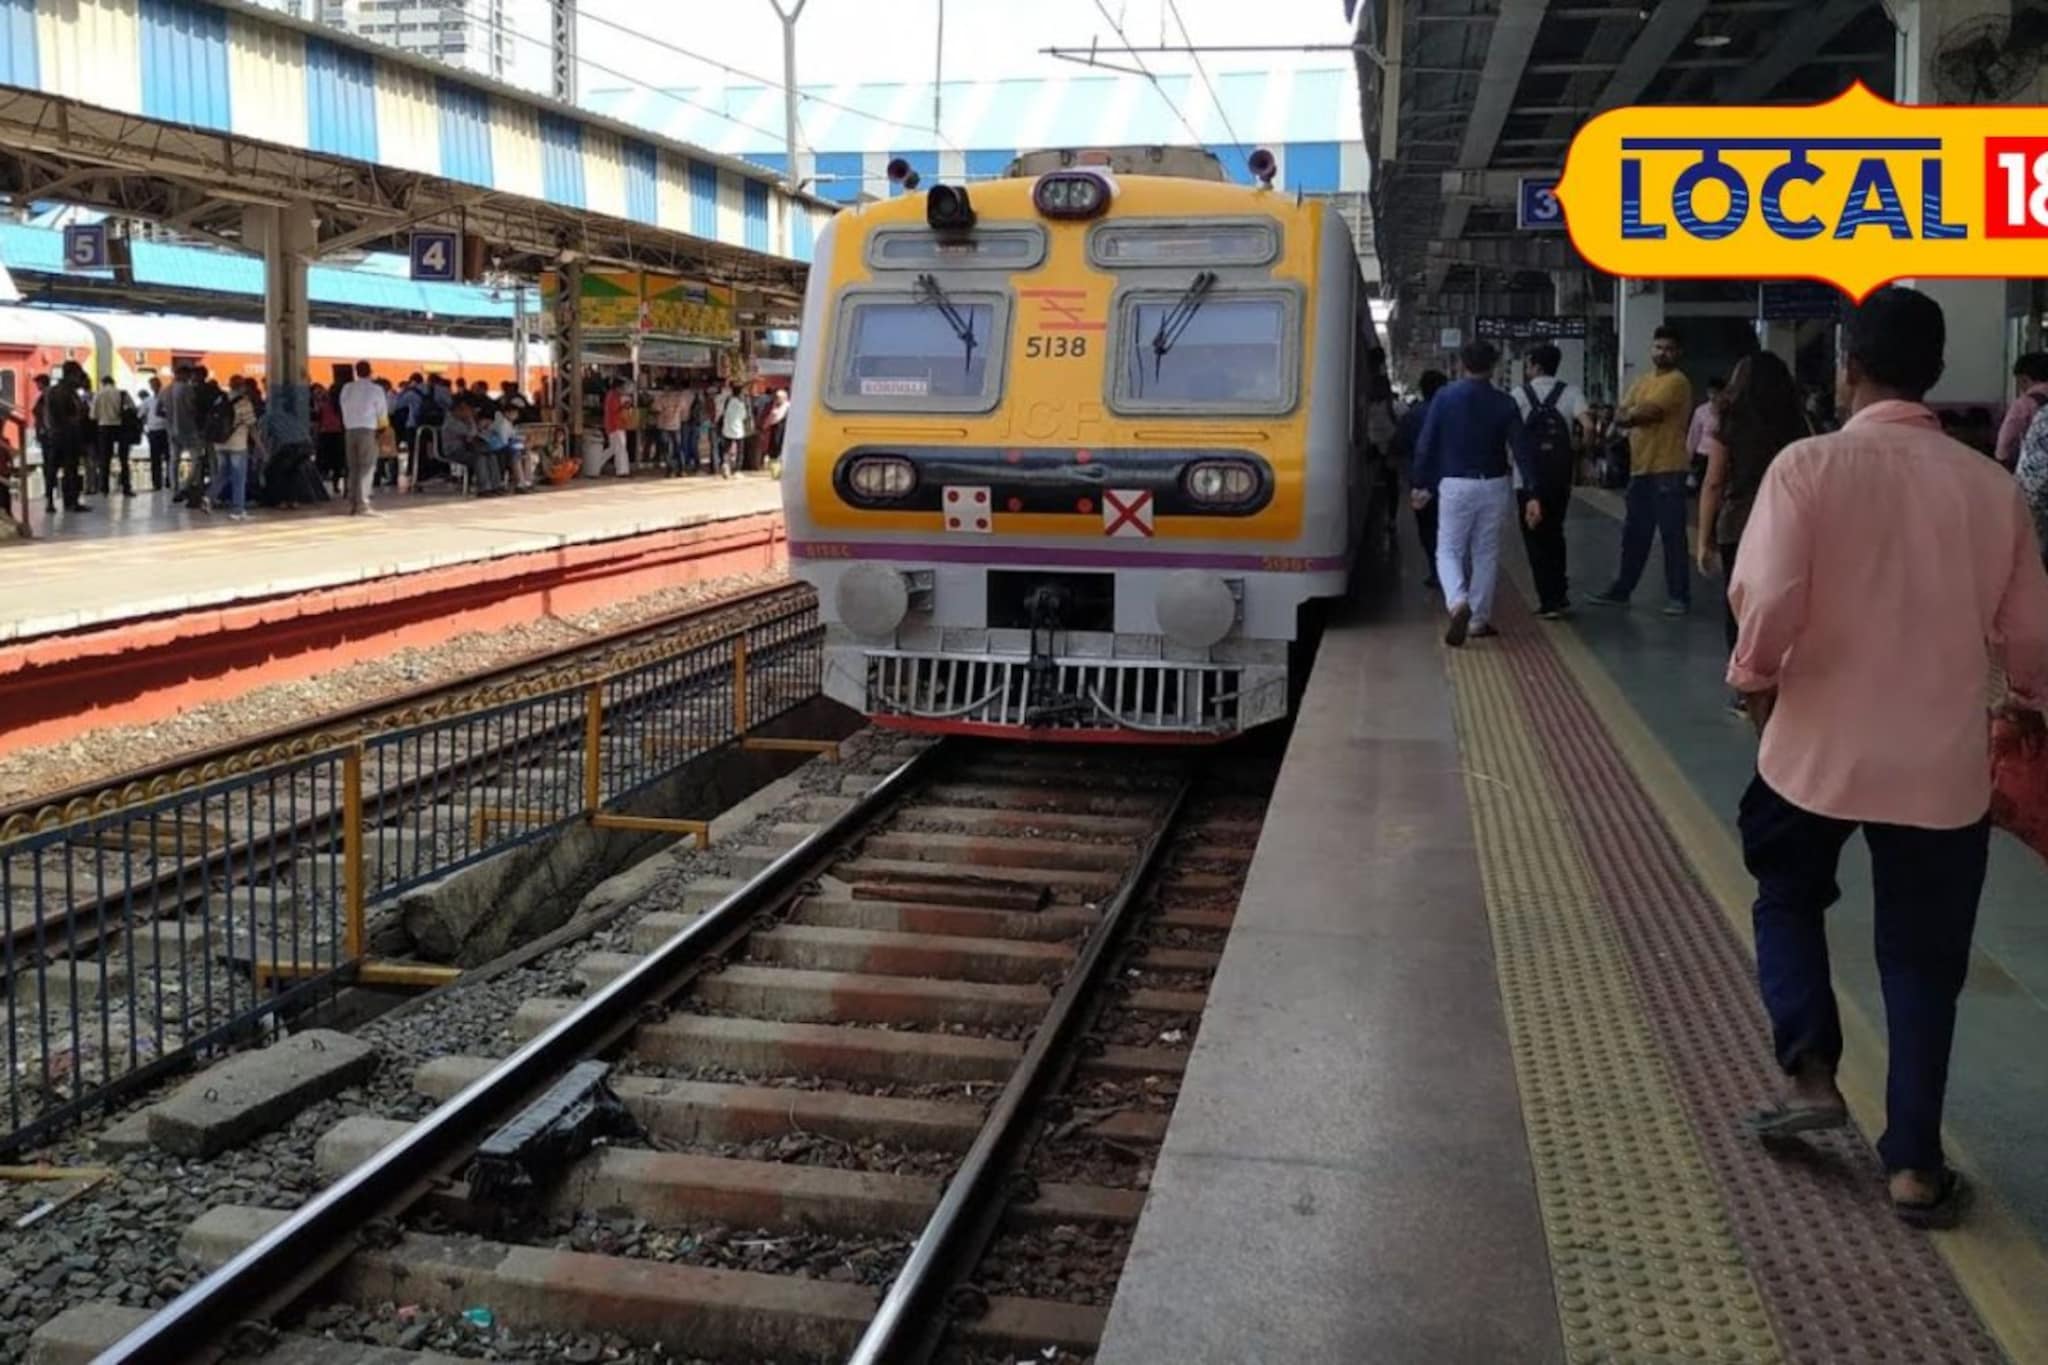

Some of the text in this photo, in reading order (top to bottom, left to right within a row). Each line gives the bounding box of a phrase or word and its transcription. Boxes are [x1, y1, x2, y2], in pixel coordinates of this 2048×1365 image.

[1534, 188, 1559, 219] 3
[74, 235, 95, 263] 5
[422, 240, 446, 271] 4
[1025, 336, 1087, 358] 5138
[1000, 398, 1103, 441] ICF
